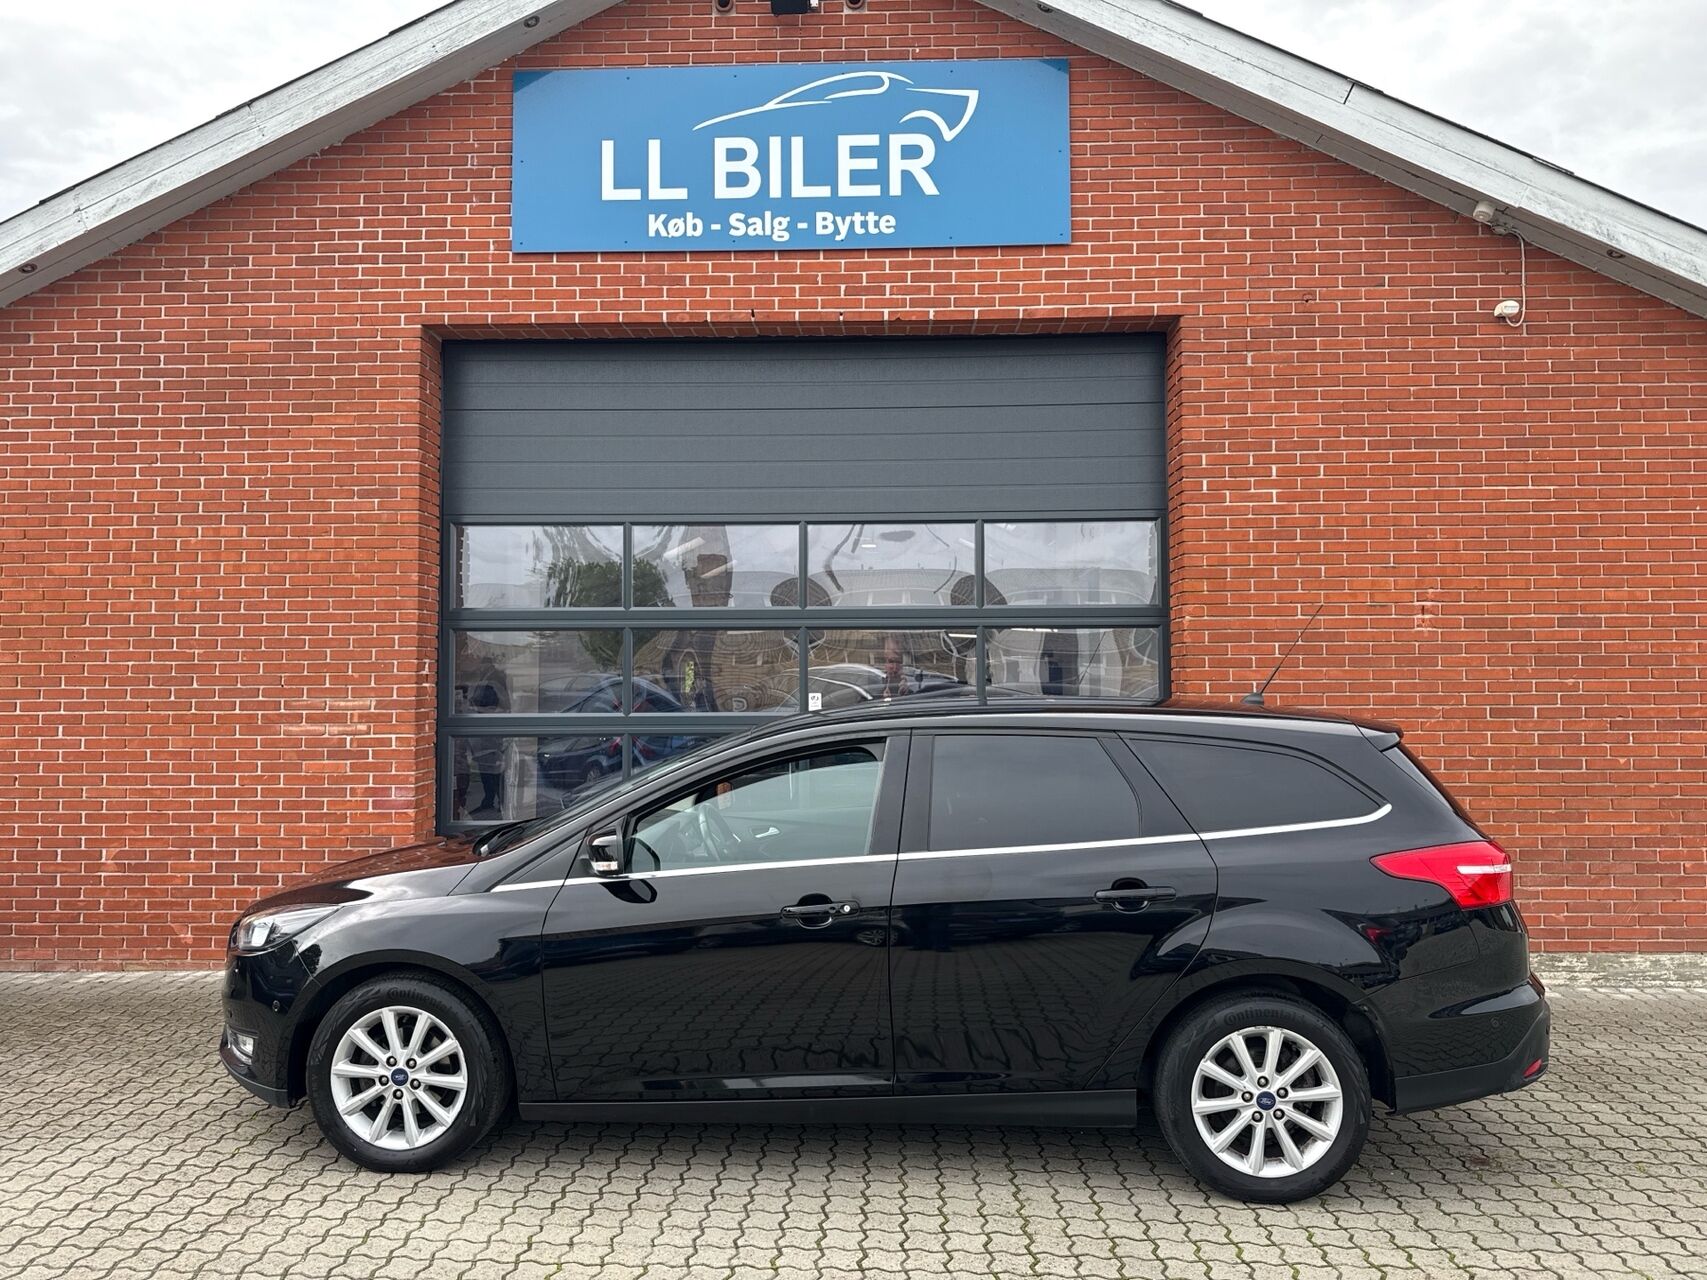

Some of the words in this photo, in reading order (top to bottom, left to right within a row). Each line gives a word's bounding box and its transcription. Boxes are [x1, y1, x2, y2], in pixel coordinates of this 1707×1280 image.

[601, 139, 688, 201] LL
[714, 133, 940, 199] BILER
[648, 213, 703, 238] Køb
[729, 211, 790, 242] Salg
[815, 211, 896, 241] Bytte
